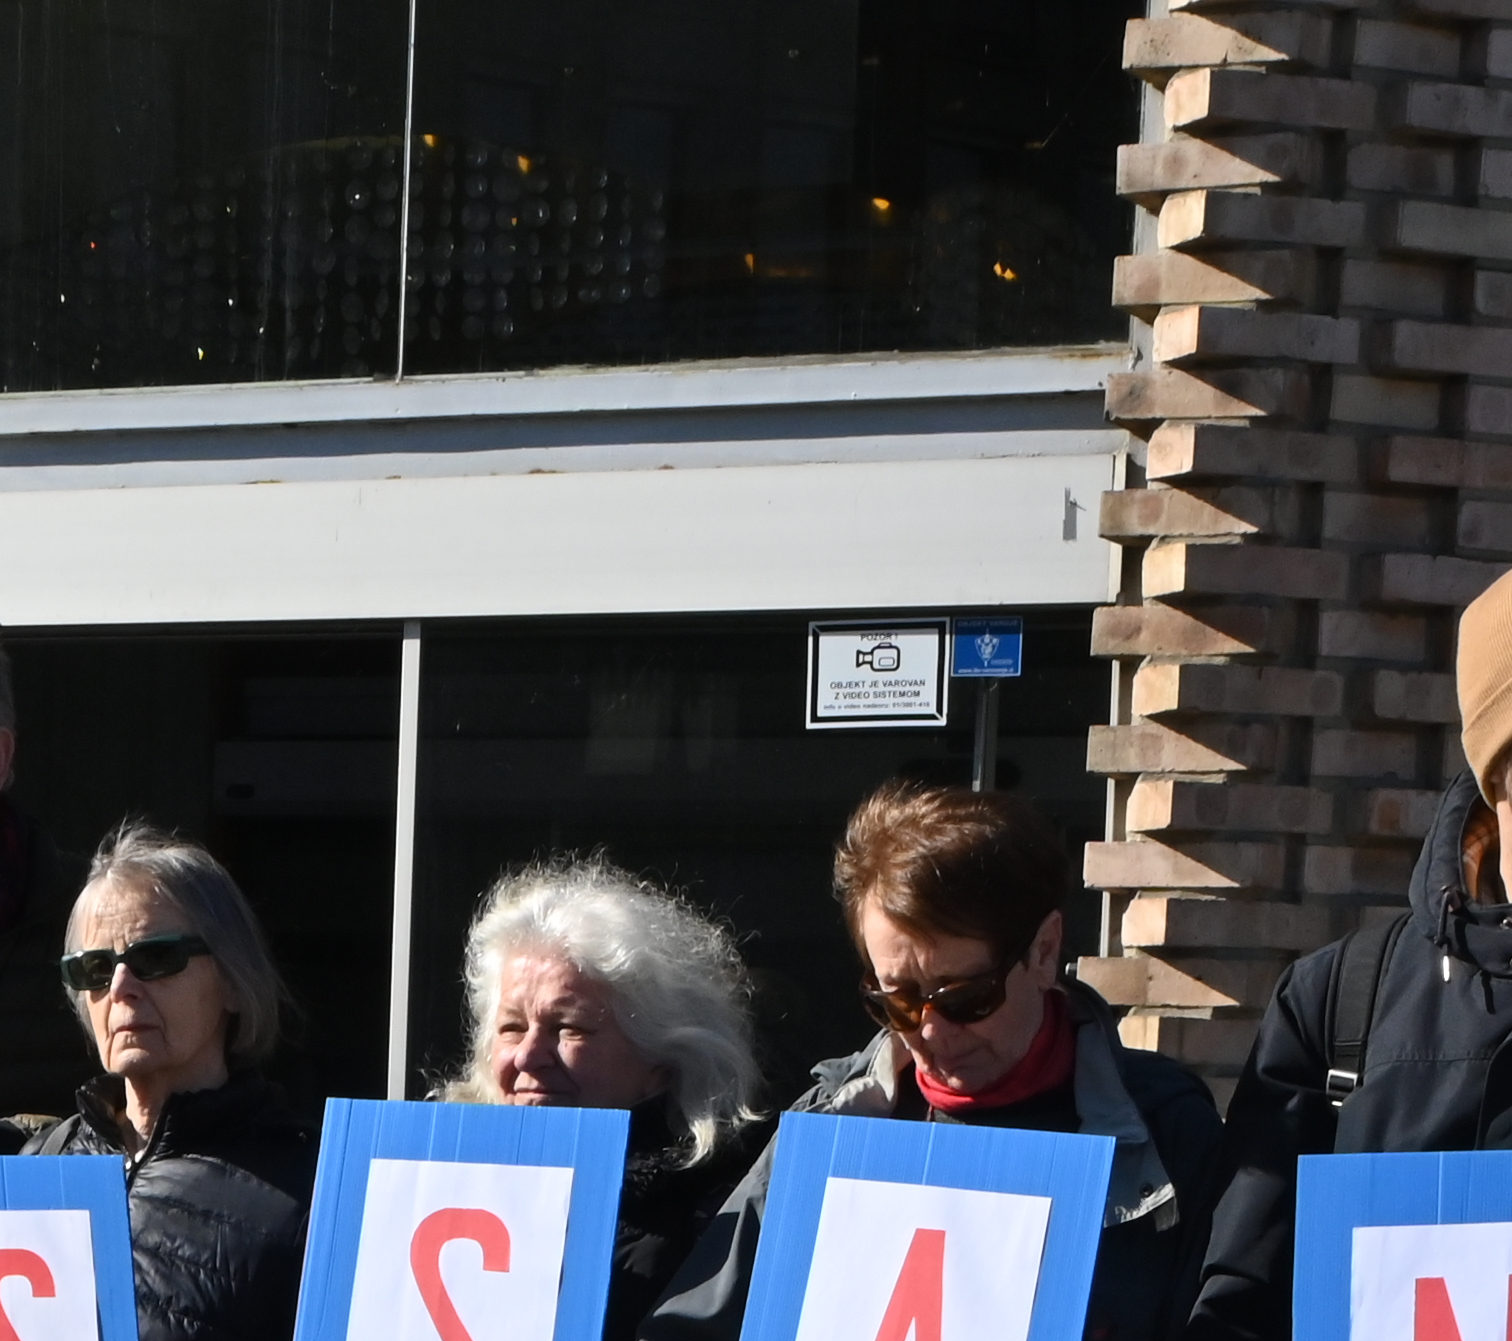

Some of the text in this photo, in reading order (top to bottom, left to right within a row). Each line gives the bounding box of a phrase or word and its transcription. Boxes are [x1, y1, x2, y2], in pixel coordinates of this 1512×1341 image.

[830, 679, 926, 689] OBJEKT JE VAROVAN
[834, 690, 921, 700] Z VIDEO SISTEMOM
